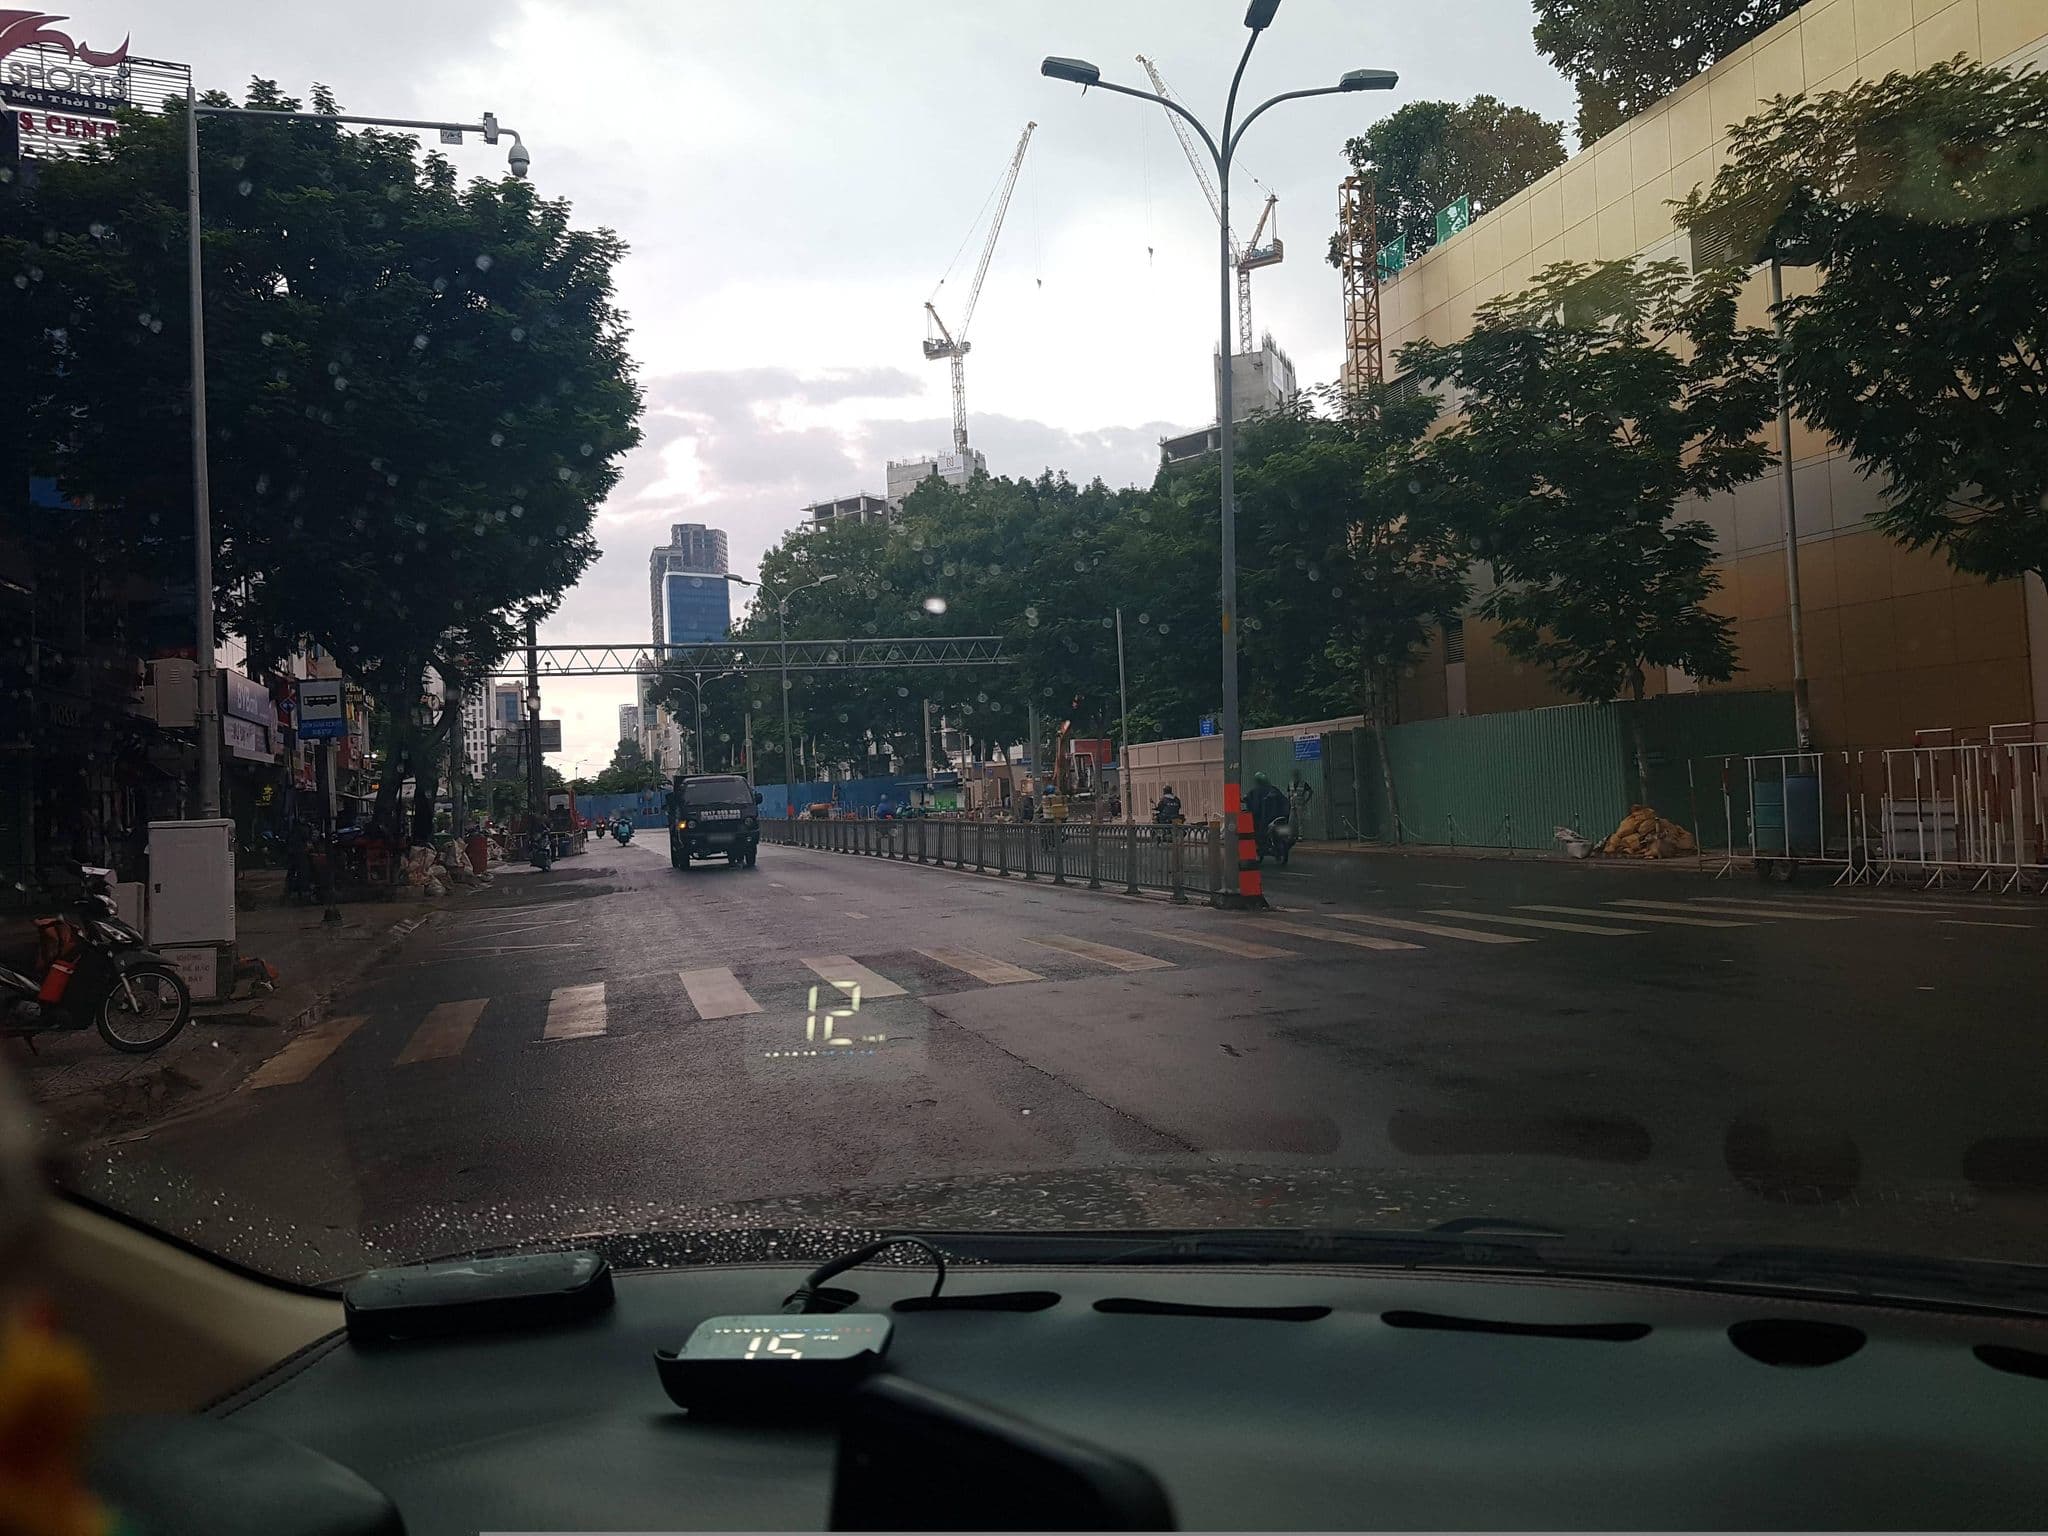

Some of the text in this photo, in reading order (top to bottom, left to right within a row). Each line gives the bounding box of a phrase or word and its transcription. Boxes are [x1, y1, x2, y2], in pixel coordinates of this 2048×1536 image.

[8, 62, 128, 99] SPORTS
[48, 95, 90, 108] Thời
[46, 115, 120, 138] CENT
[806, 981, 861, 1046] 12
